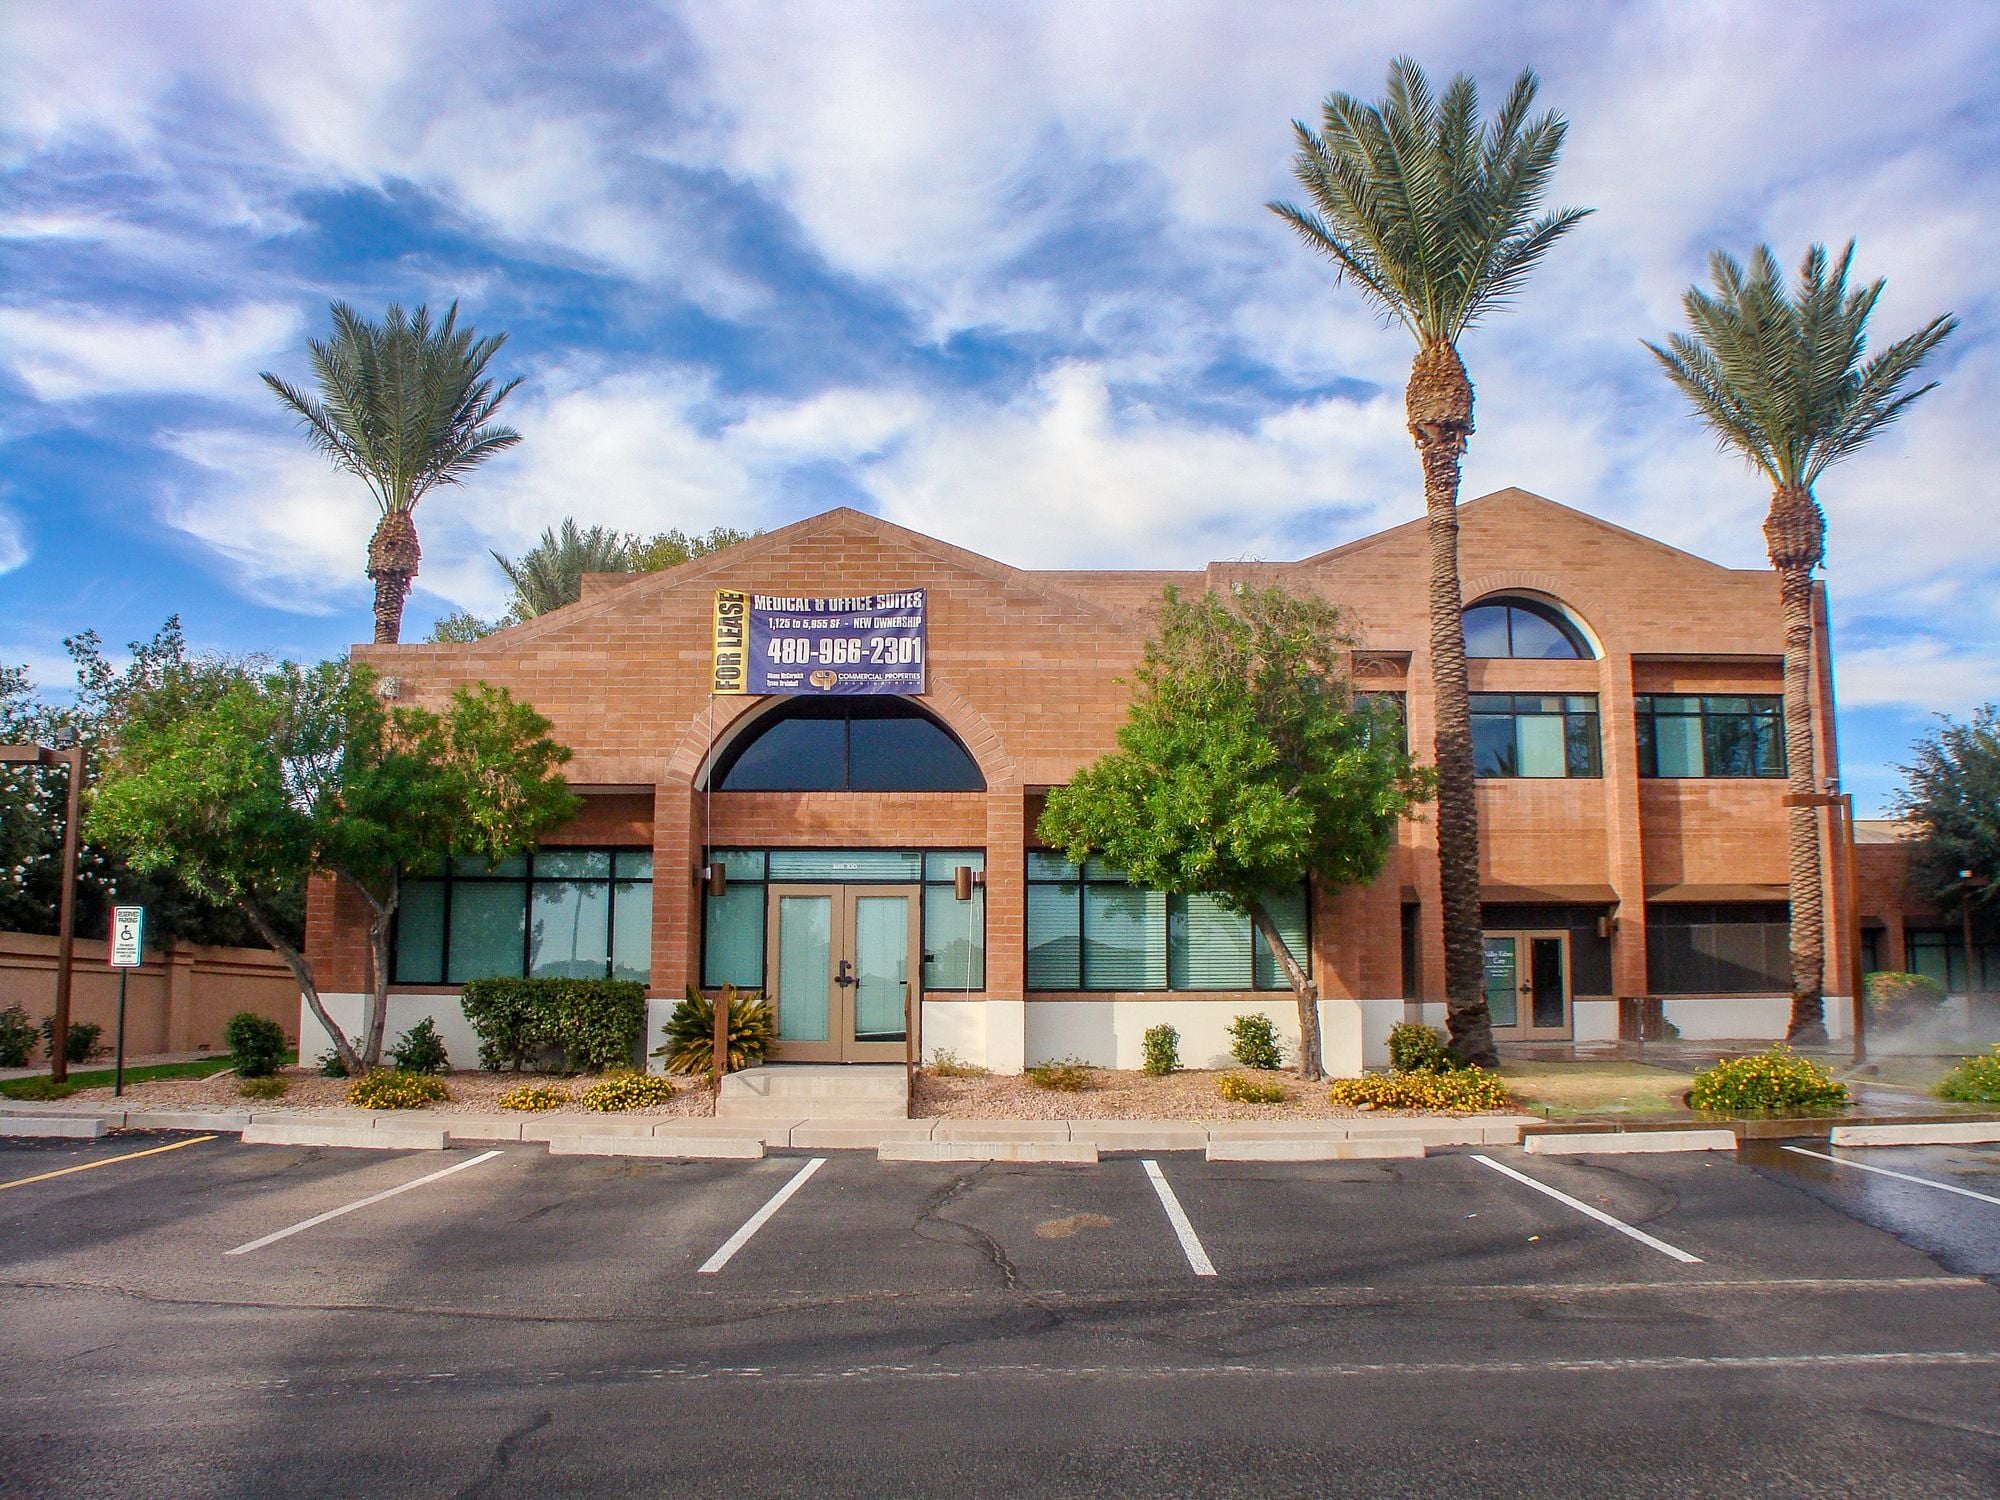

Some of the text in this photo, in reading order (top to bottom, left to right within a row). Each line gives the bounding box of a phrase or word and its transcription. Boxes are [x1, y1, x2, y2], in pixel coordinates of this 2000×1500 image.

[754, 591, 923, 612] MEDICAL & OFFICE SUITES
[768, 617, 791, 631] 1,125
[793, 618, 801, 629] to
[829, 618, 841, 629] SF
[853, 617, 872, 629] NEW
[874, 615, 922, 629] OWNERSHIP
[715, 592, 744, 691] FOR LEASE
[767, 636, 922, 665] 480-966-2301
[838, 672, 921, 680] COMMERCIAL PROPERTIES
